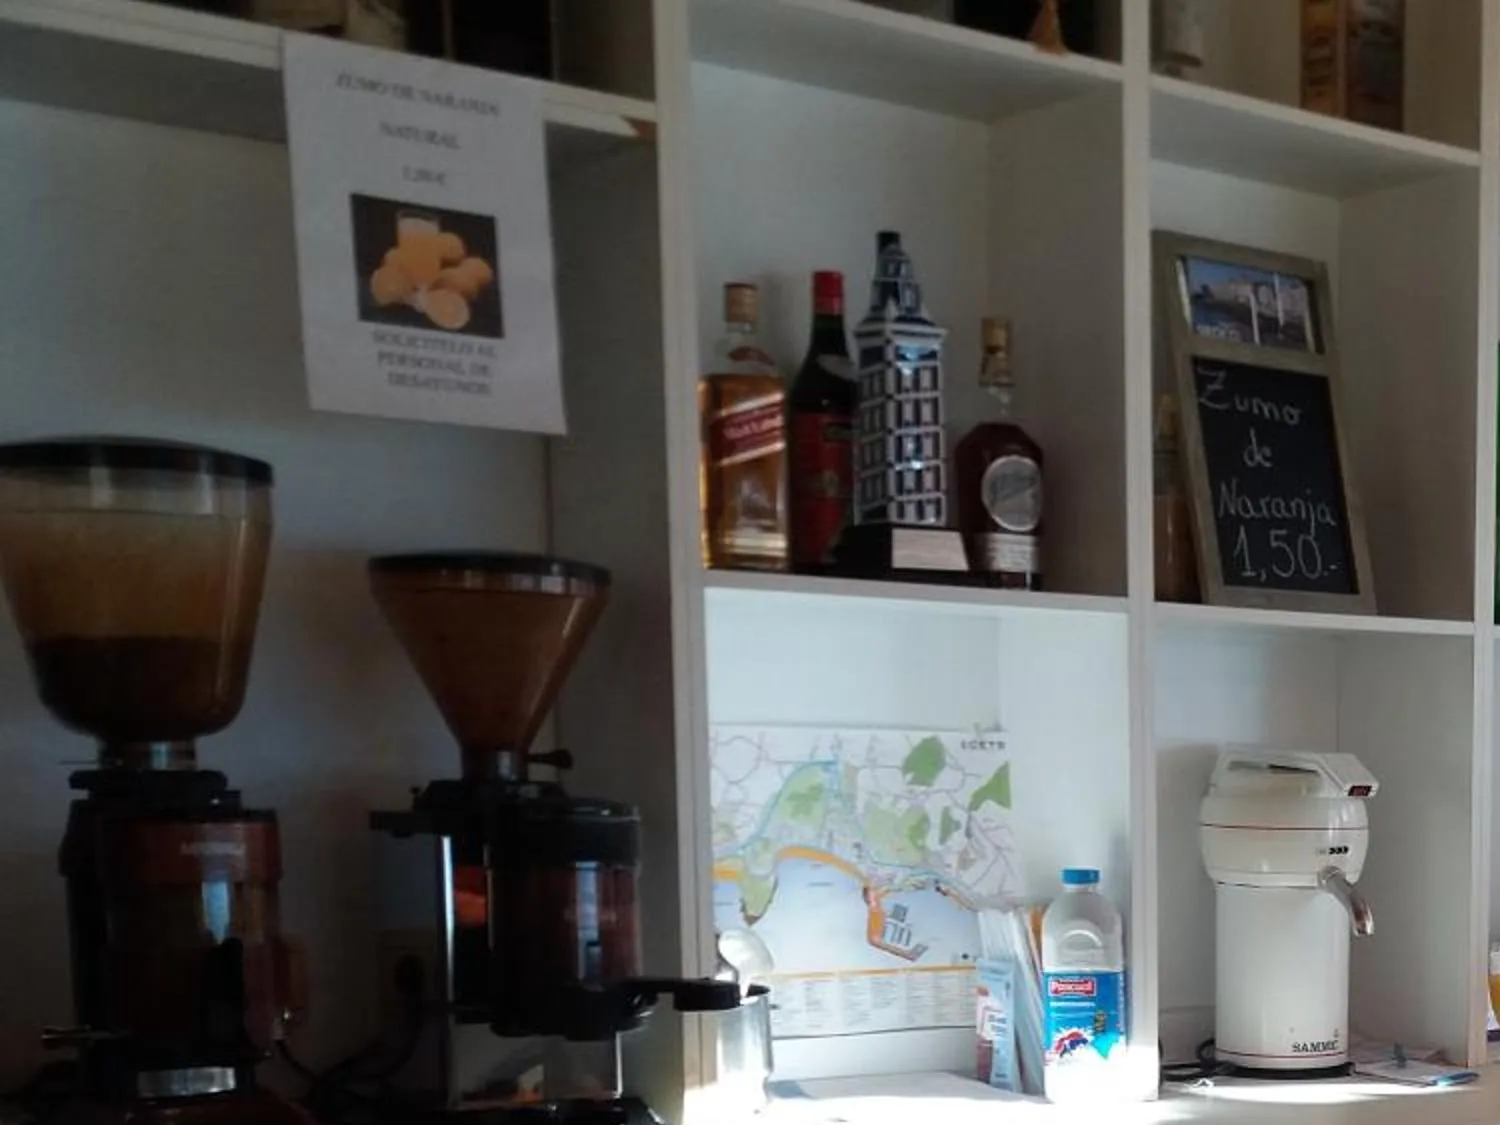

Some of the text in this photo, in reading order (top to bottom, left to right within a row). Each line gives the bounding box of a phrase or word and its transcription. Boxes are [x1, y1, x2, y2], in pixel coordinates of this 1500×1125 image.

[1199, 366, 1301, 426] Zumo
[1242, 425, 1273, 468] de
[1217, 478, 1336, 540] Naranja
